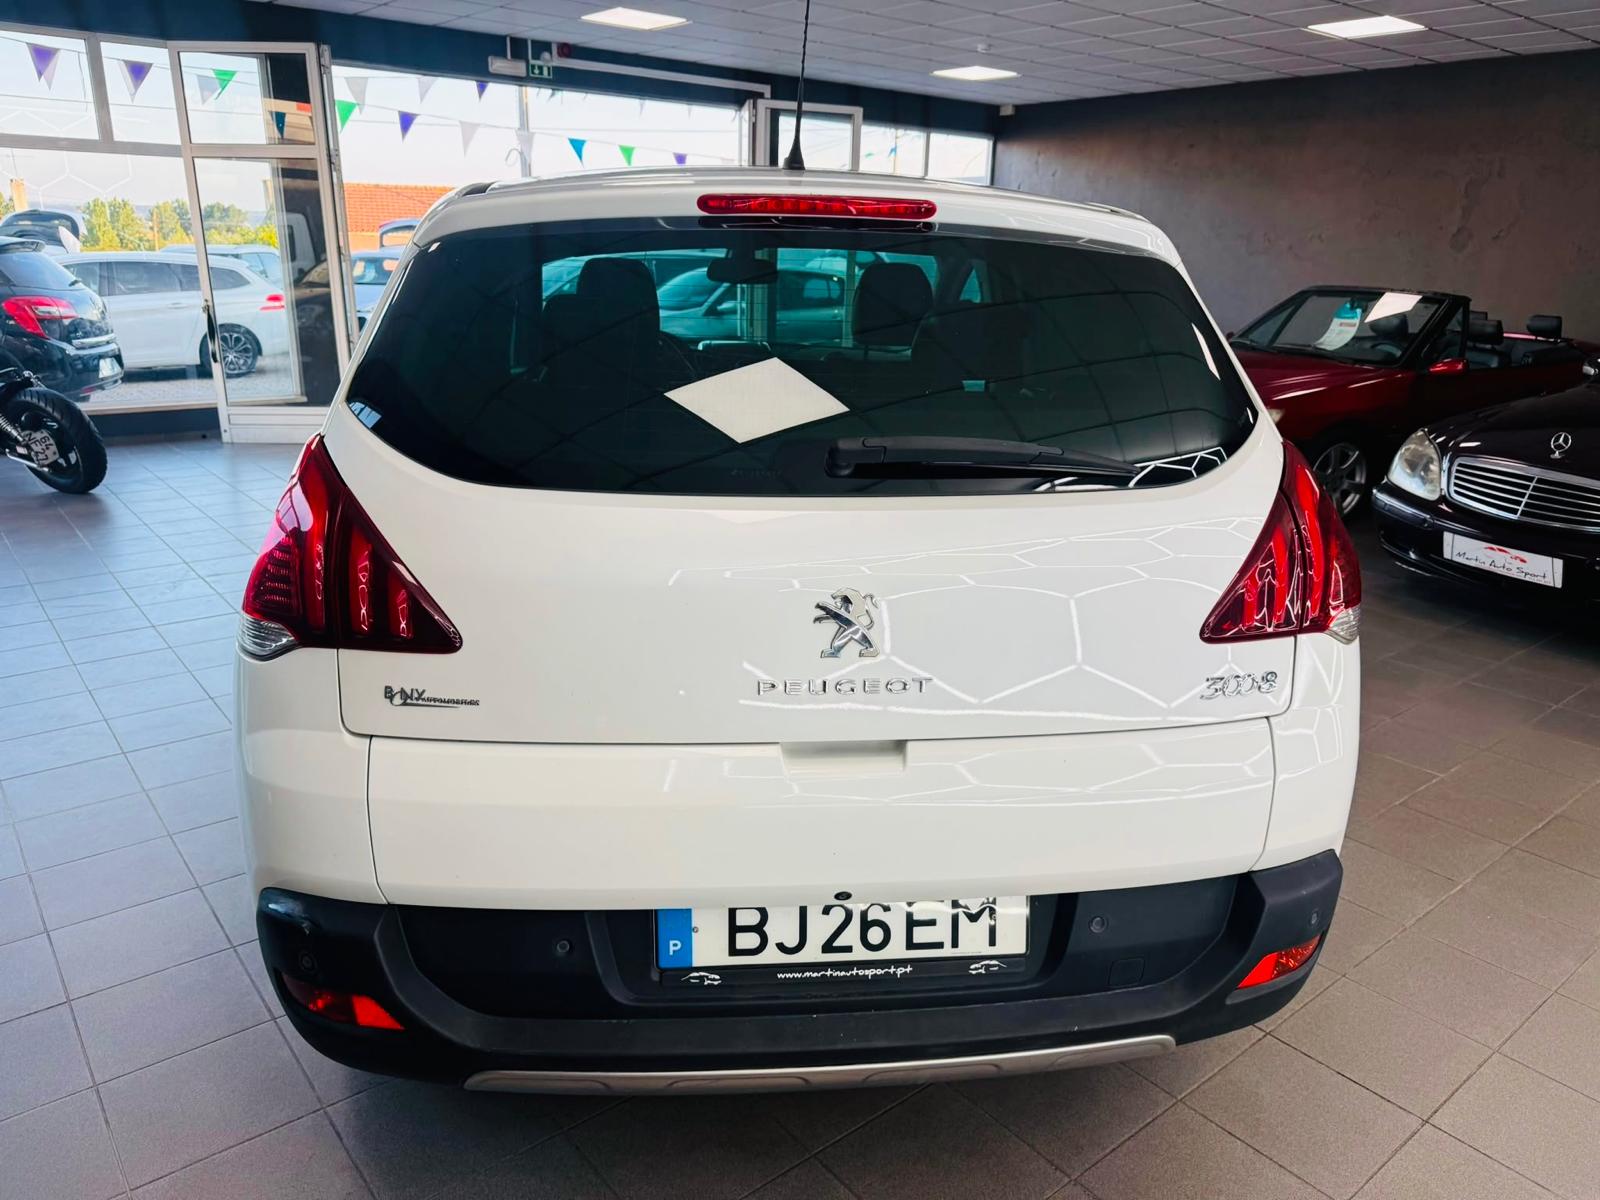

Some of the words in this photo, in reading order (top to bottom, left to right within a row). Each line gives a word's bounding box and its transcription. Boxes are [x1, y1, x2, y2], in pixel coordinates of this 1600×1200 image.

[1455, 551, 1486, 565] Martin
[1489, 559, 1513, 572] Auto
[1516, 566, 1547, 579] Sport
[757, 677, 933, 696] PEUGEOT
[1200, 671, 1278, 700] 3008
[669, 940, 682, 956] P
[777, 964, 913, 980] www.martinautosport.pt
